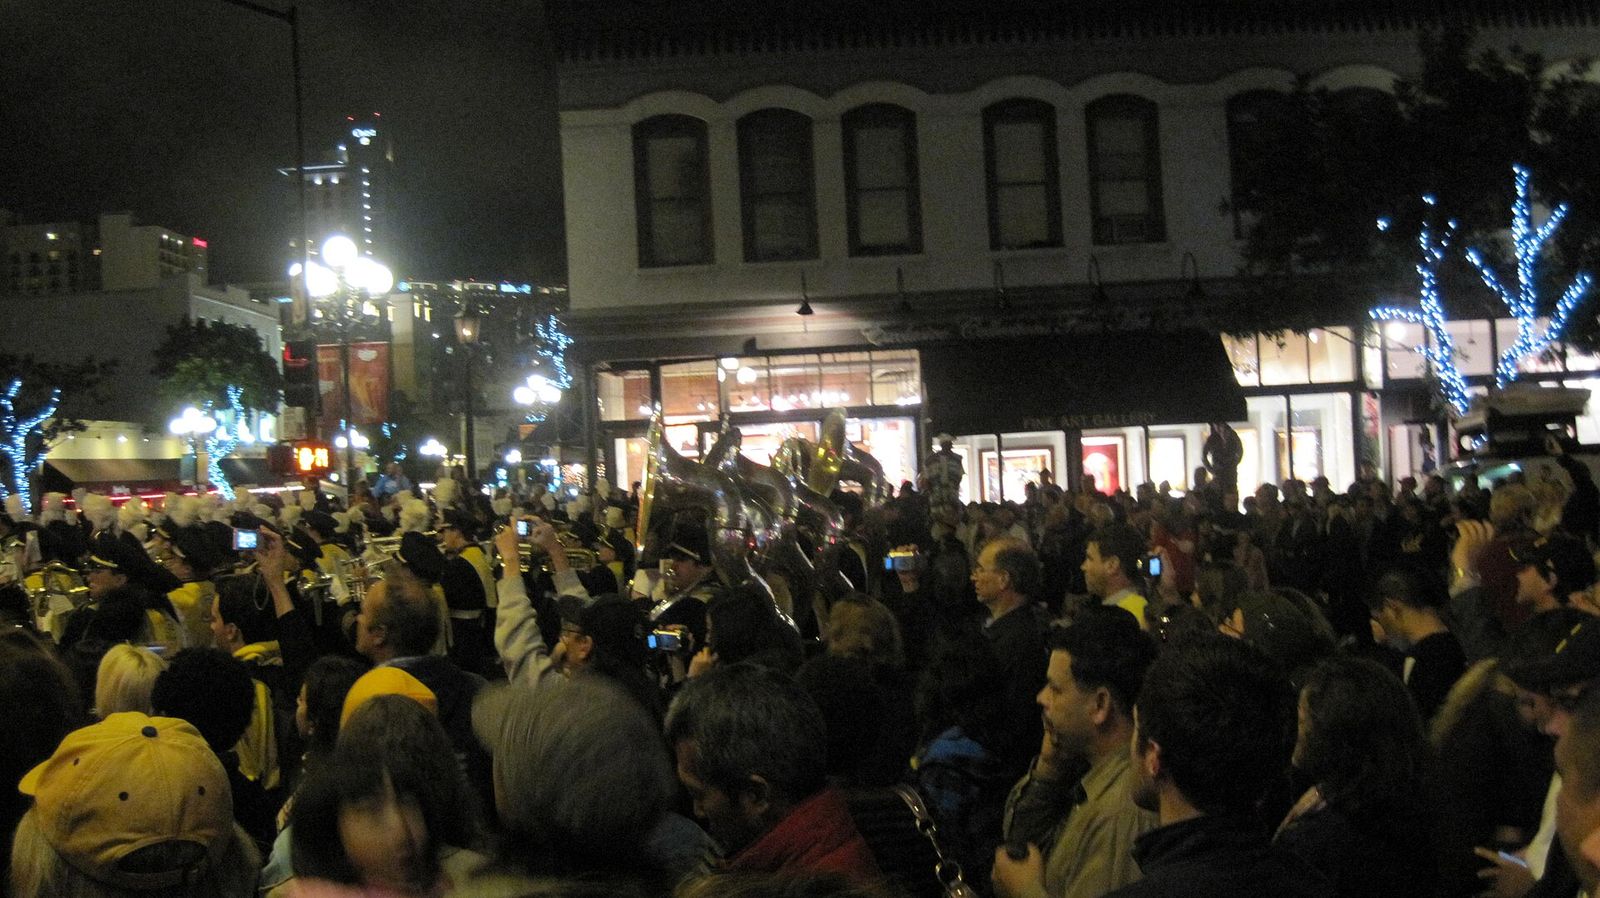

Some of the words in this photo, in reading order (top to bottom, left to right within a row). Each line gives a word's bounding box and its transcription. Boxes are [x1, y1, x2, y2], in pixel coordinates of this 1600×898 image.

[1023, 417, 1052, 430] FINE
[1060, 415, 1088, 428] ART
[1092, 412, 1156, 427] GALLERY
